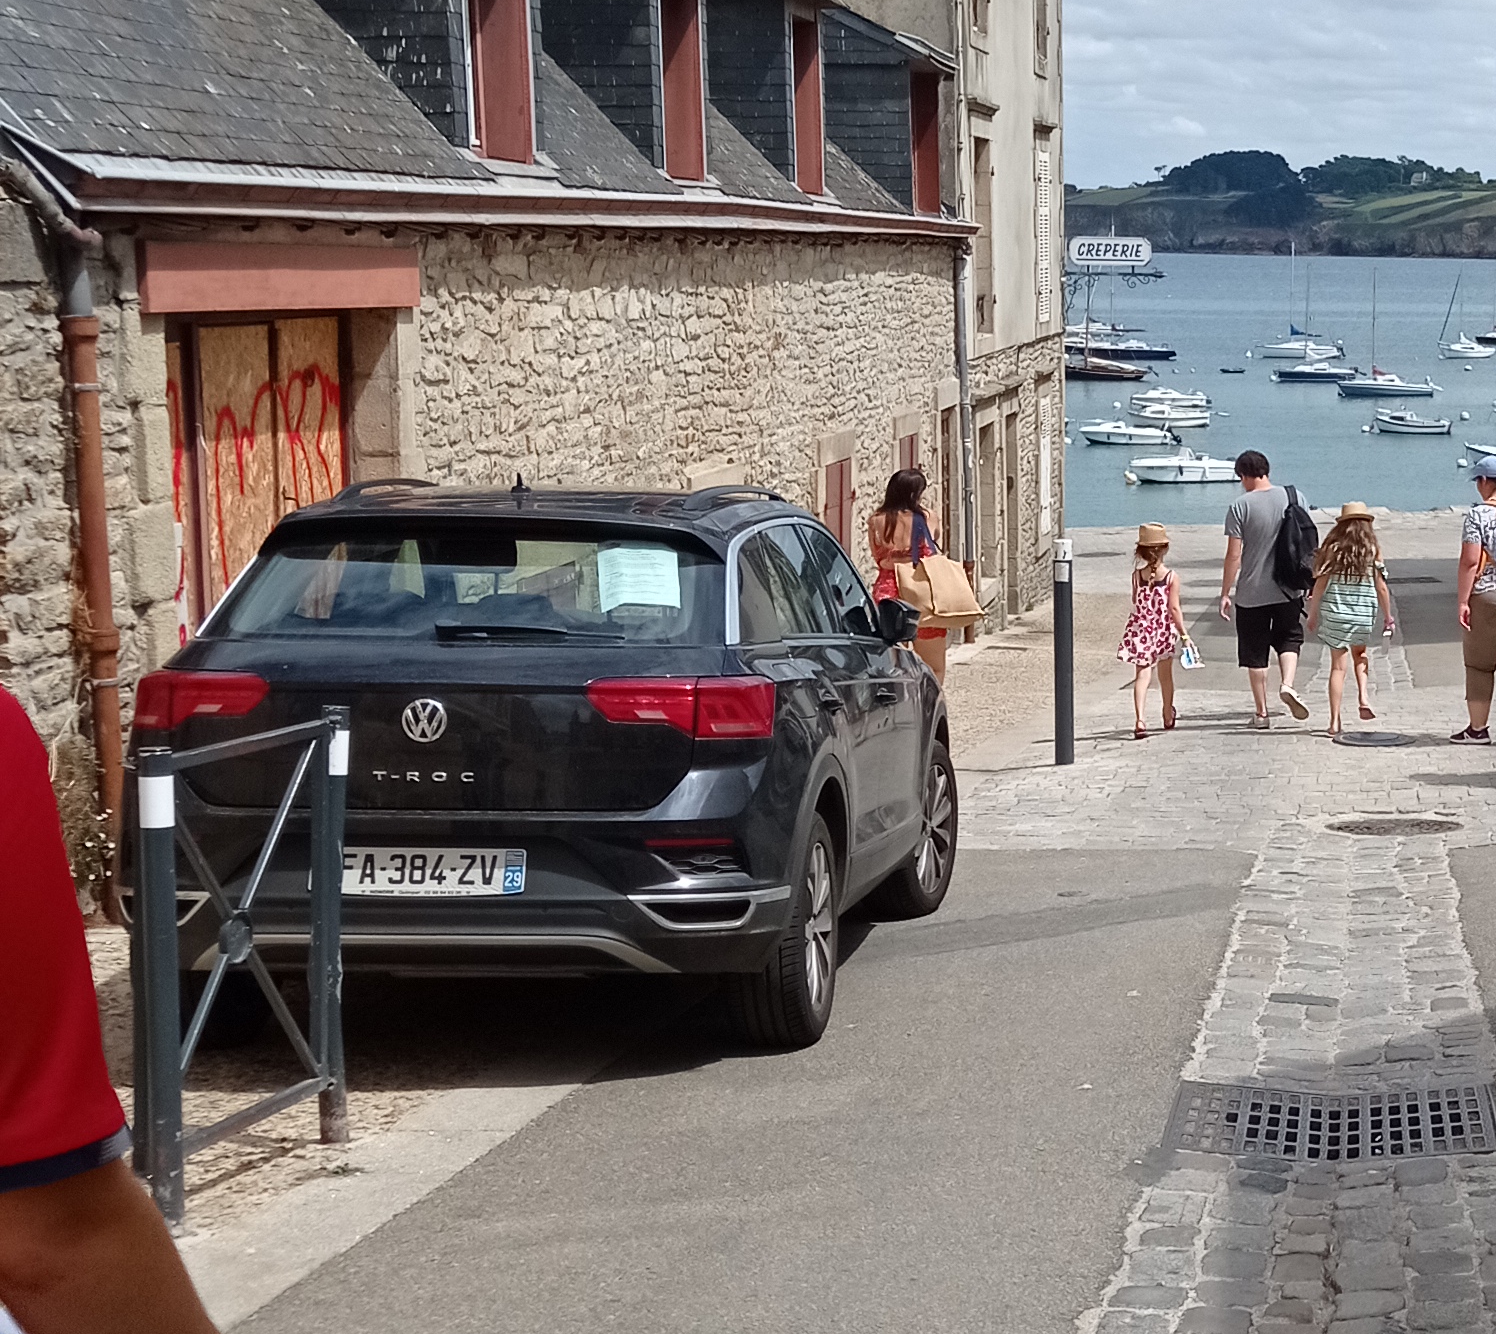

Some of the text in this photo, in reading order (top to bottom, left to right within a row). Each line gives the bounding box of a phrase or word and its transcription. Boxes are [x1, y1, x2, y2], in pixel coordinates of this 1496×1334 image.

[1077, 242, 1143, 258] CREPERIE
[372, 771, 475, 783] T-ROC
[504, 872, 522, 887] 29
